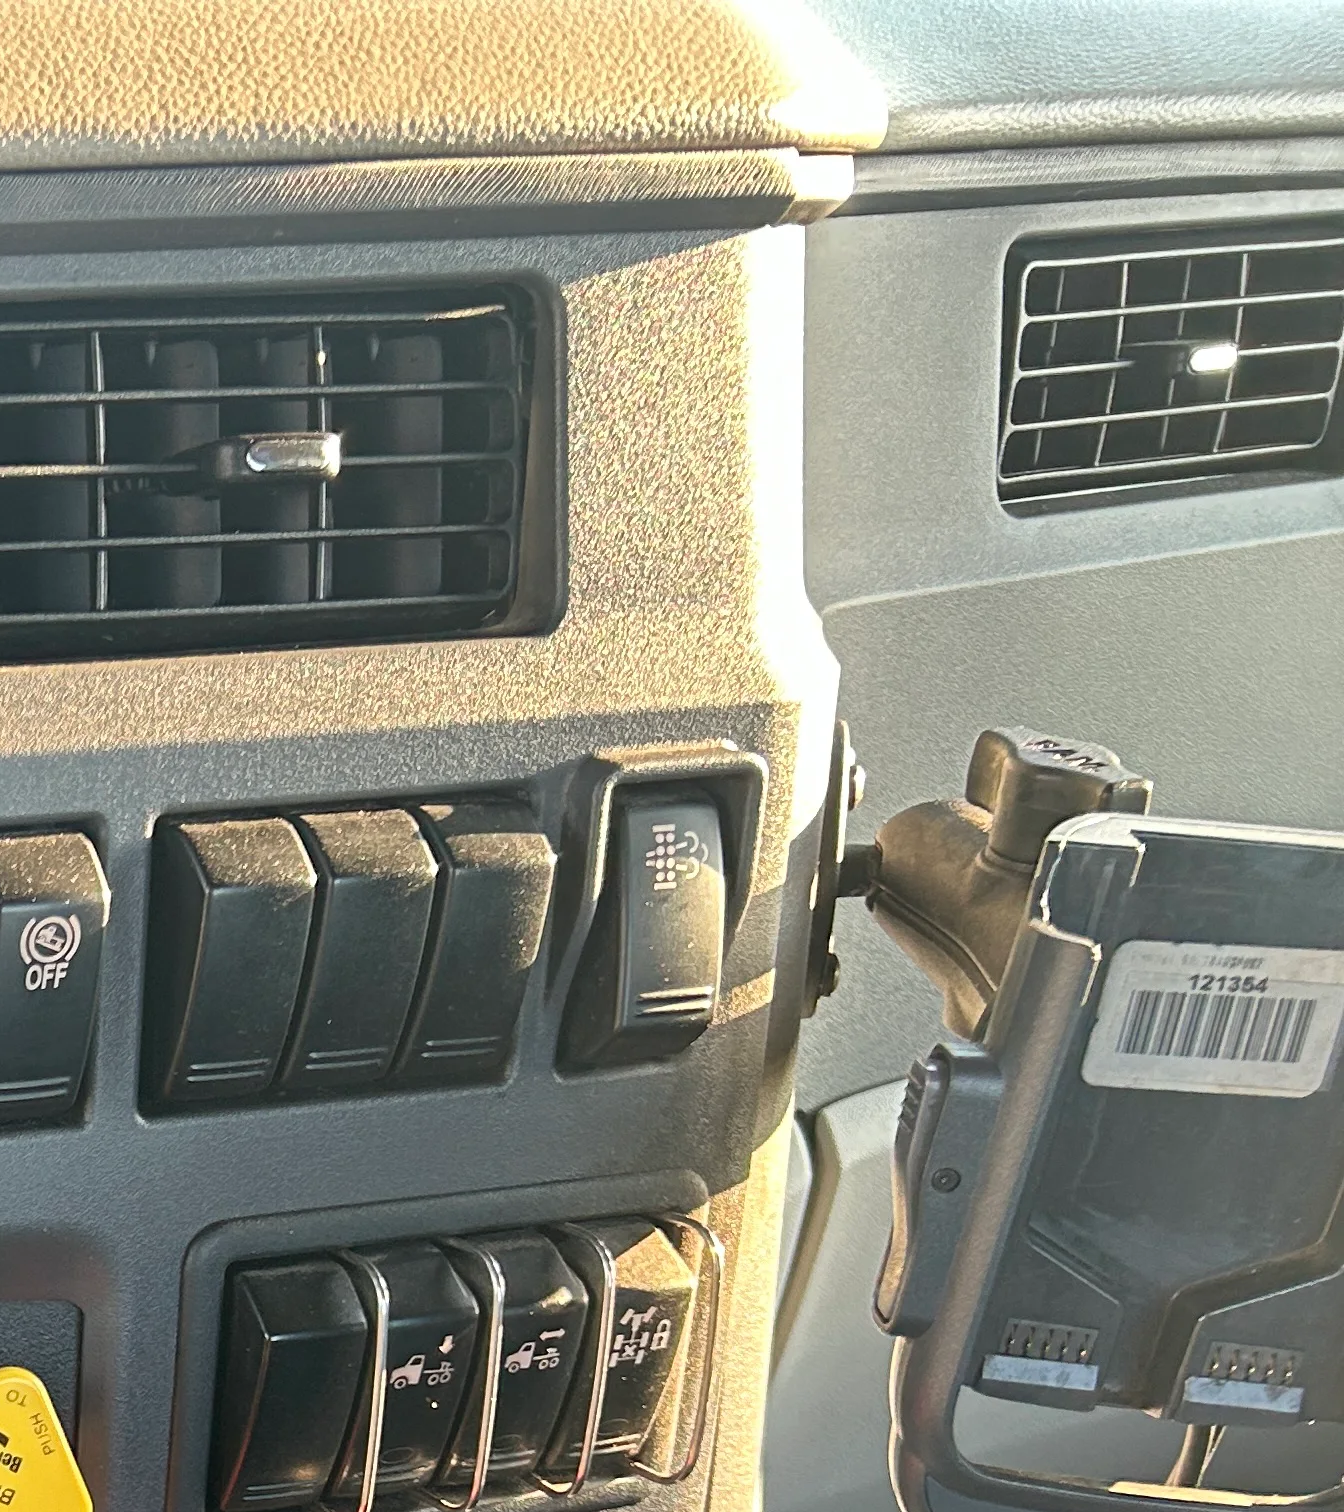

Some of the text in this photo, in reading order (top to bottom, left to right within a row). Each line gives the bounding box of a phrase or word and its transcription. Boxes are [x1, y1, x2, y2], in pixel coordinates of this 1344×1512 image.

[25, 961, 71, 992] OFF
[1189, 973, 1269, 993] 121354
[6, 1389, 28, 1407] TO
[29, 1412, 56, 1456] PUSH
